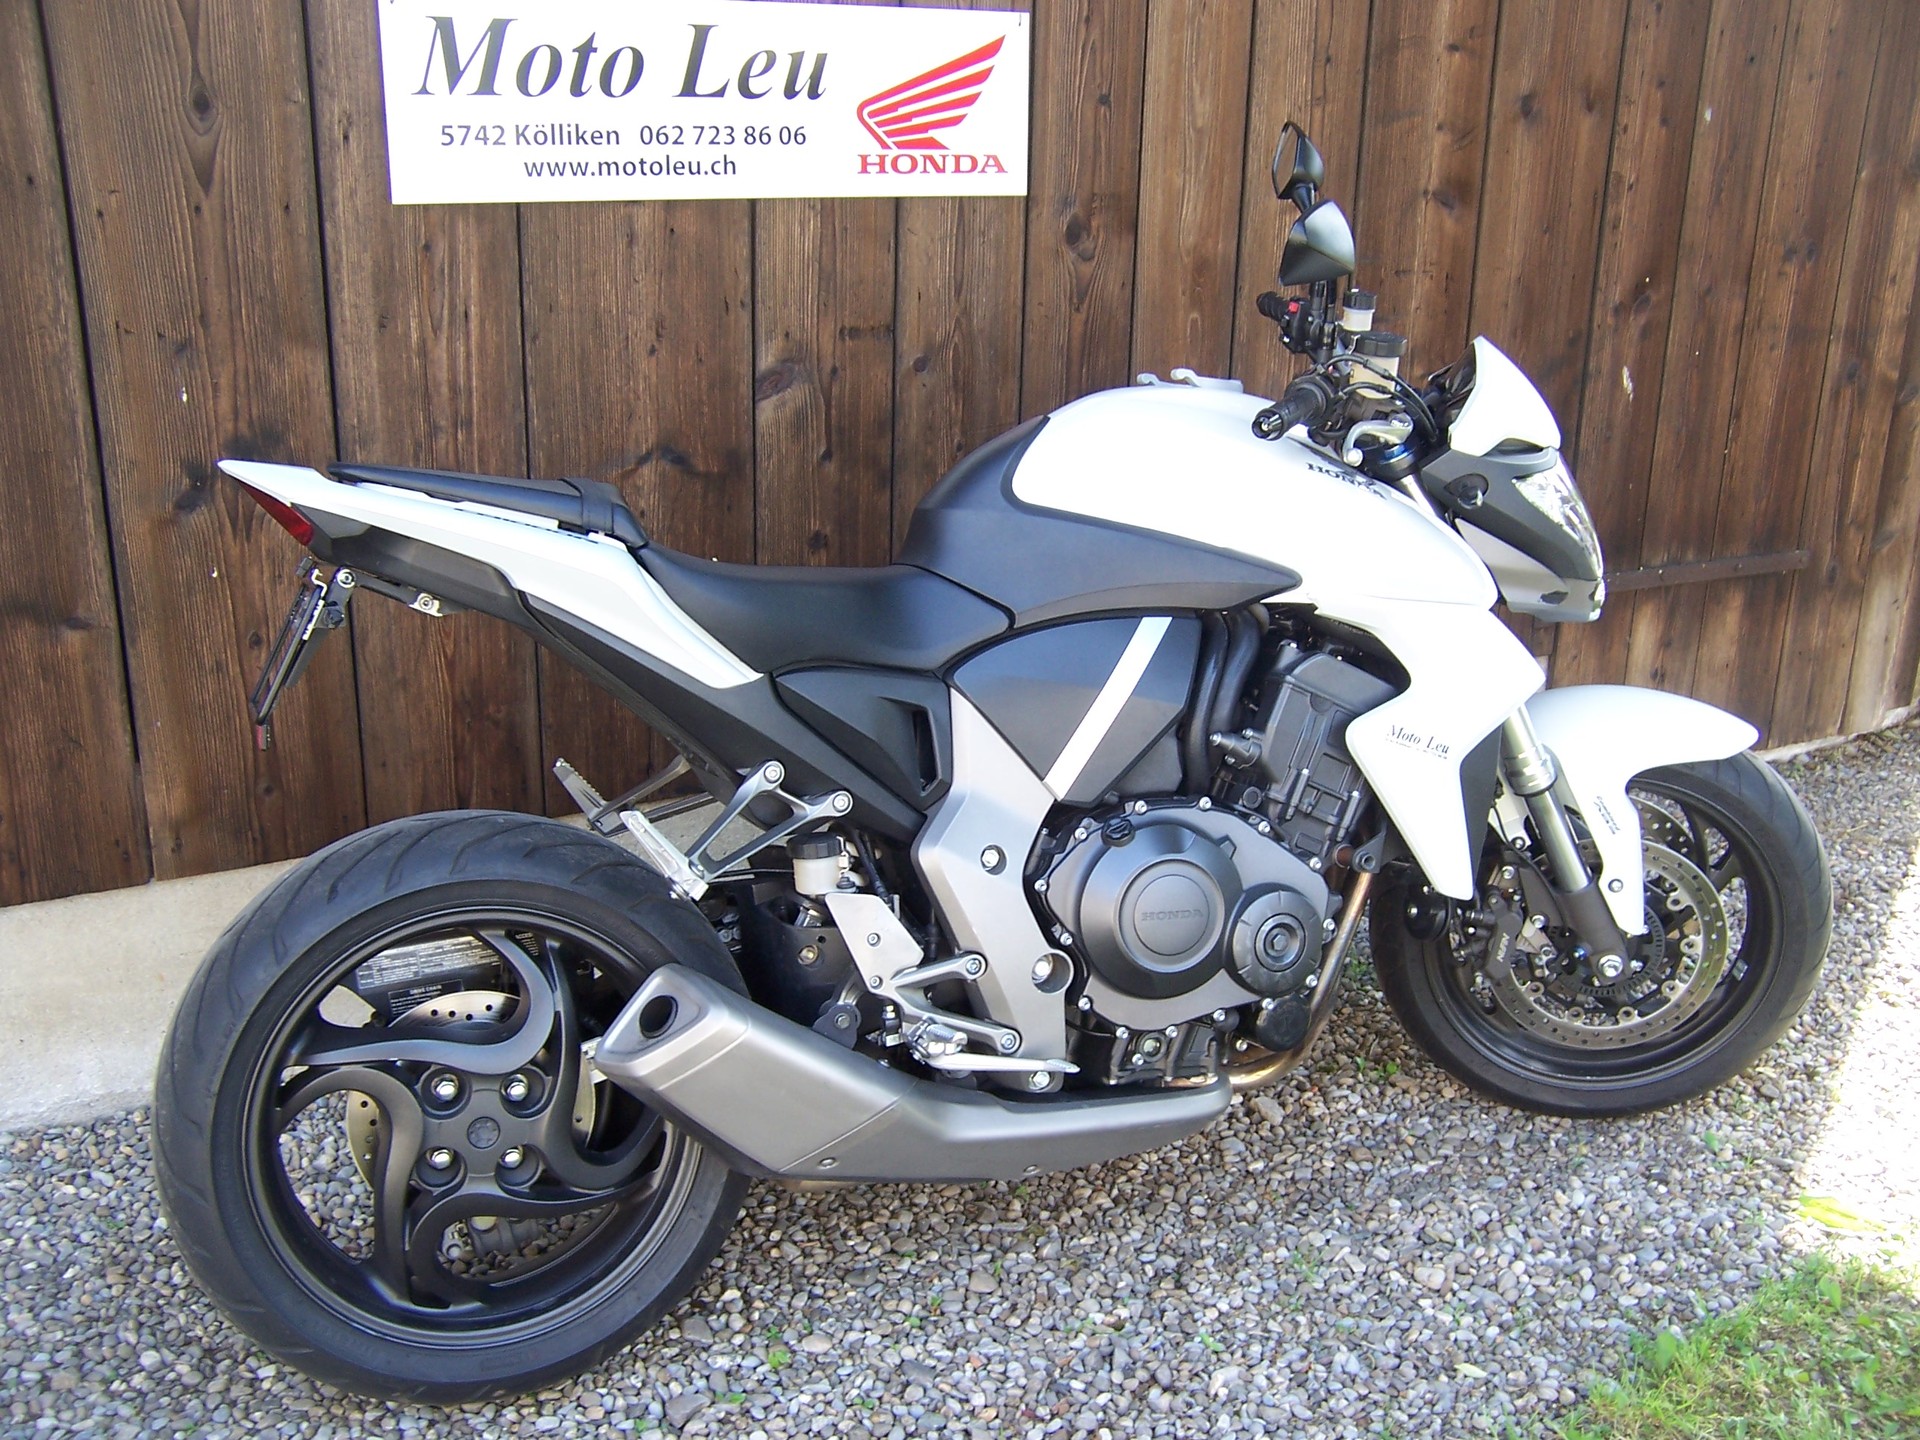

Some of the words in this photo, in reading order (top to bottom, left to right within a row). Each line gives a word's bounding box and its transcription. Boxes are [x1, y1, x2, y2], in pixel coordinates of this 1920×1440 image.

[412, 15, 645, 98] Moto
[673, 24, 829, 100] Leu
[441, 125, 506, 146] 5742
[515, 123, 620, 146] Kölliken
[639, 125, 685, 146] 062
[692, 125, 736, 146] 723
[743, 125, 772, 146] 86
[779, 125, 807, 146] 06
[523, 154, 737, 177] www.motoleu.ch
[857, 154, 1008, 174] HONDA
[1387, 724, 1421, 745] Moto
[1426, 736, 1449, 754] Leu
[1141, 909, 1204, 922] HONDA
